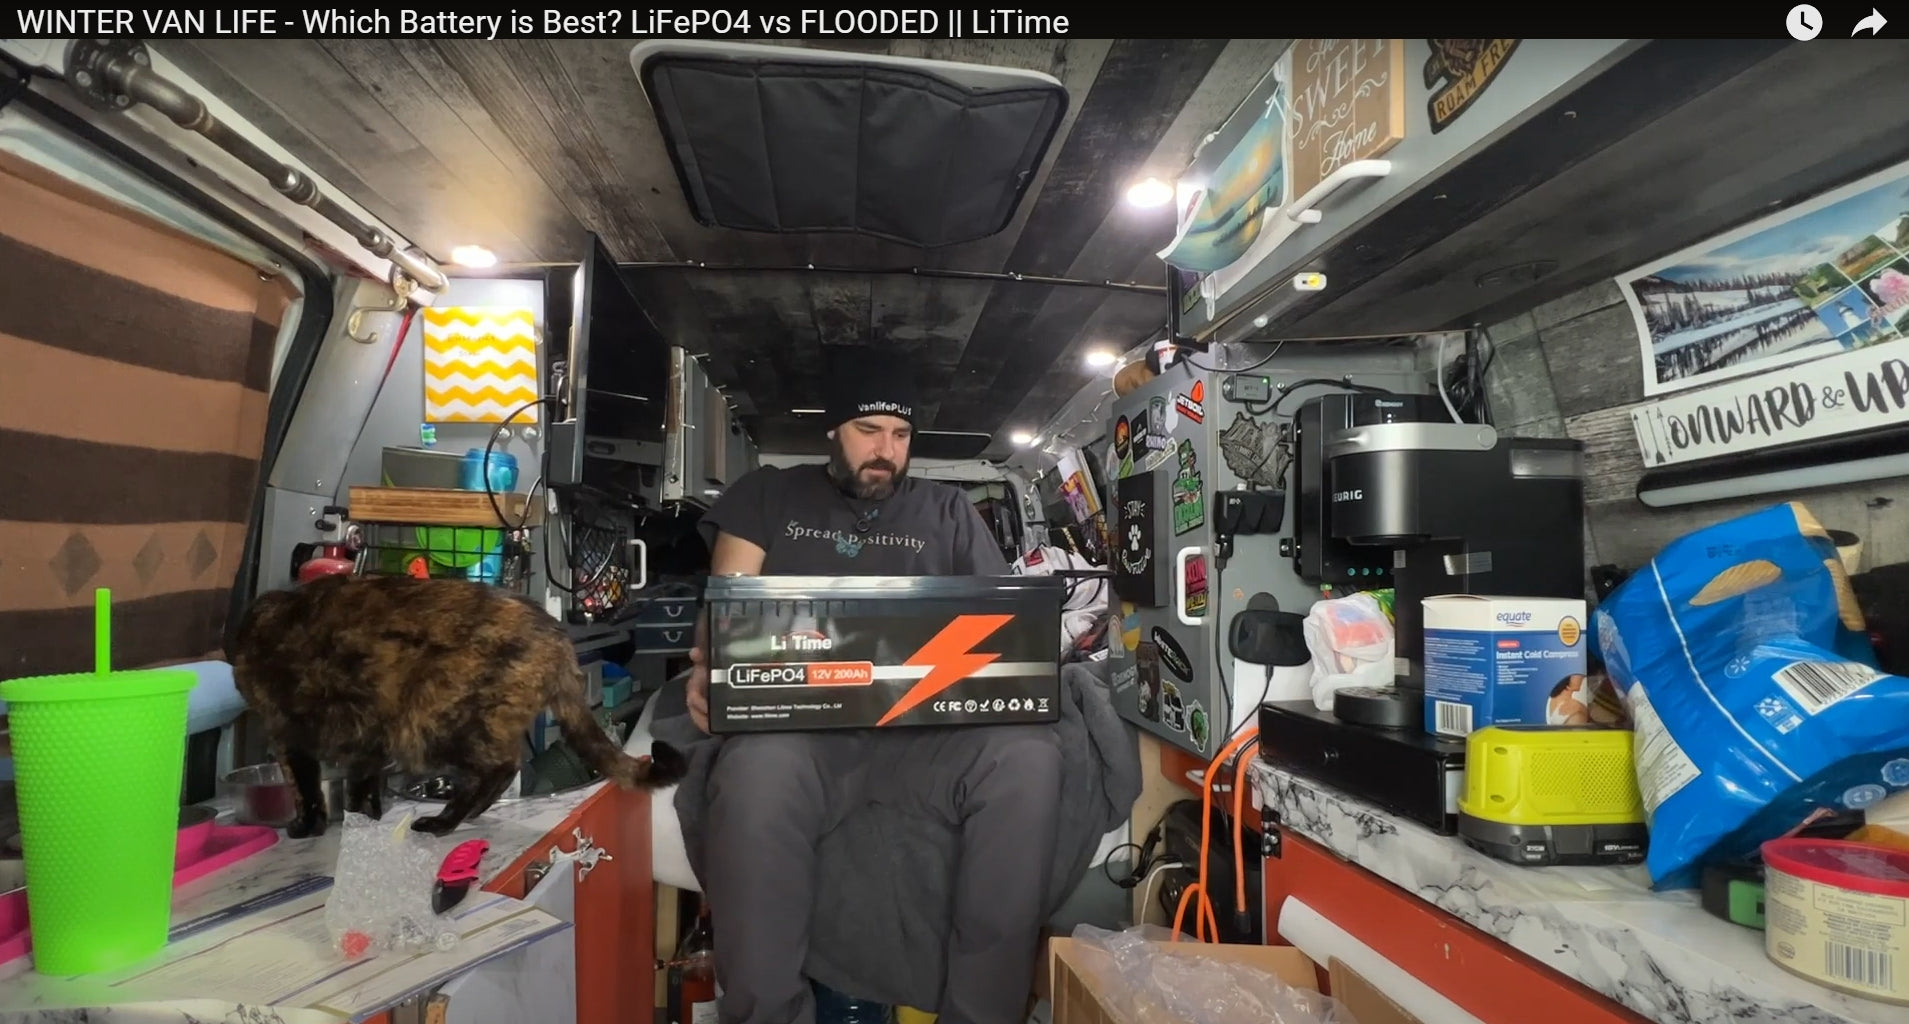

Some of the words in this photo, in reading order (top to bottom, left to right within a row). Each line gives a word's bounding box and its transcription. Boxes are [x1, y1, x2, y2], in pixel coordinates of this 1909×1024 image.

[1320, 121, 1377, 177] Home
[1667, 381, 1817, 449] ONWARD
[1822, 385, 1846, 409] &
[784, 520, 842, 541] Spread
[1496, 610, 1532, 624] equate
[770, 634, 787, 650] Li
[792, 634, 832, 650] Time
[736, 667, 805, 683] LiFePO4
[812, 669, 832, 680] 12V
[834, 667, 869, 680] 200Ah
